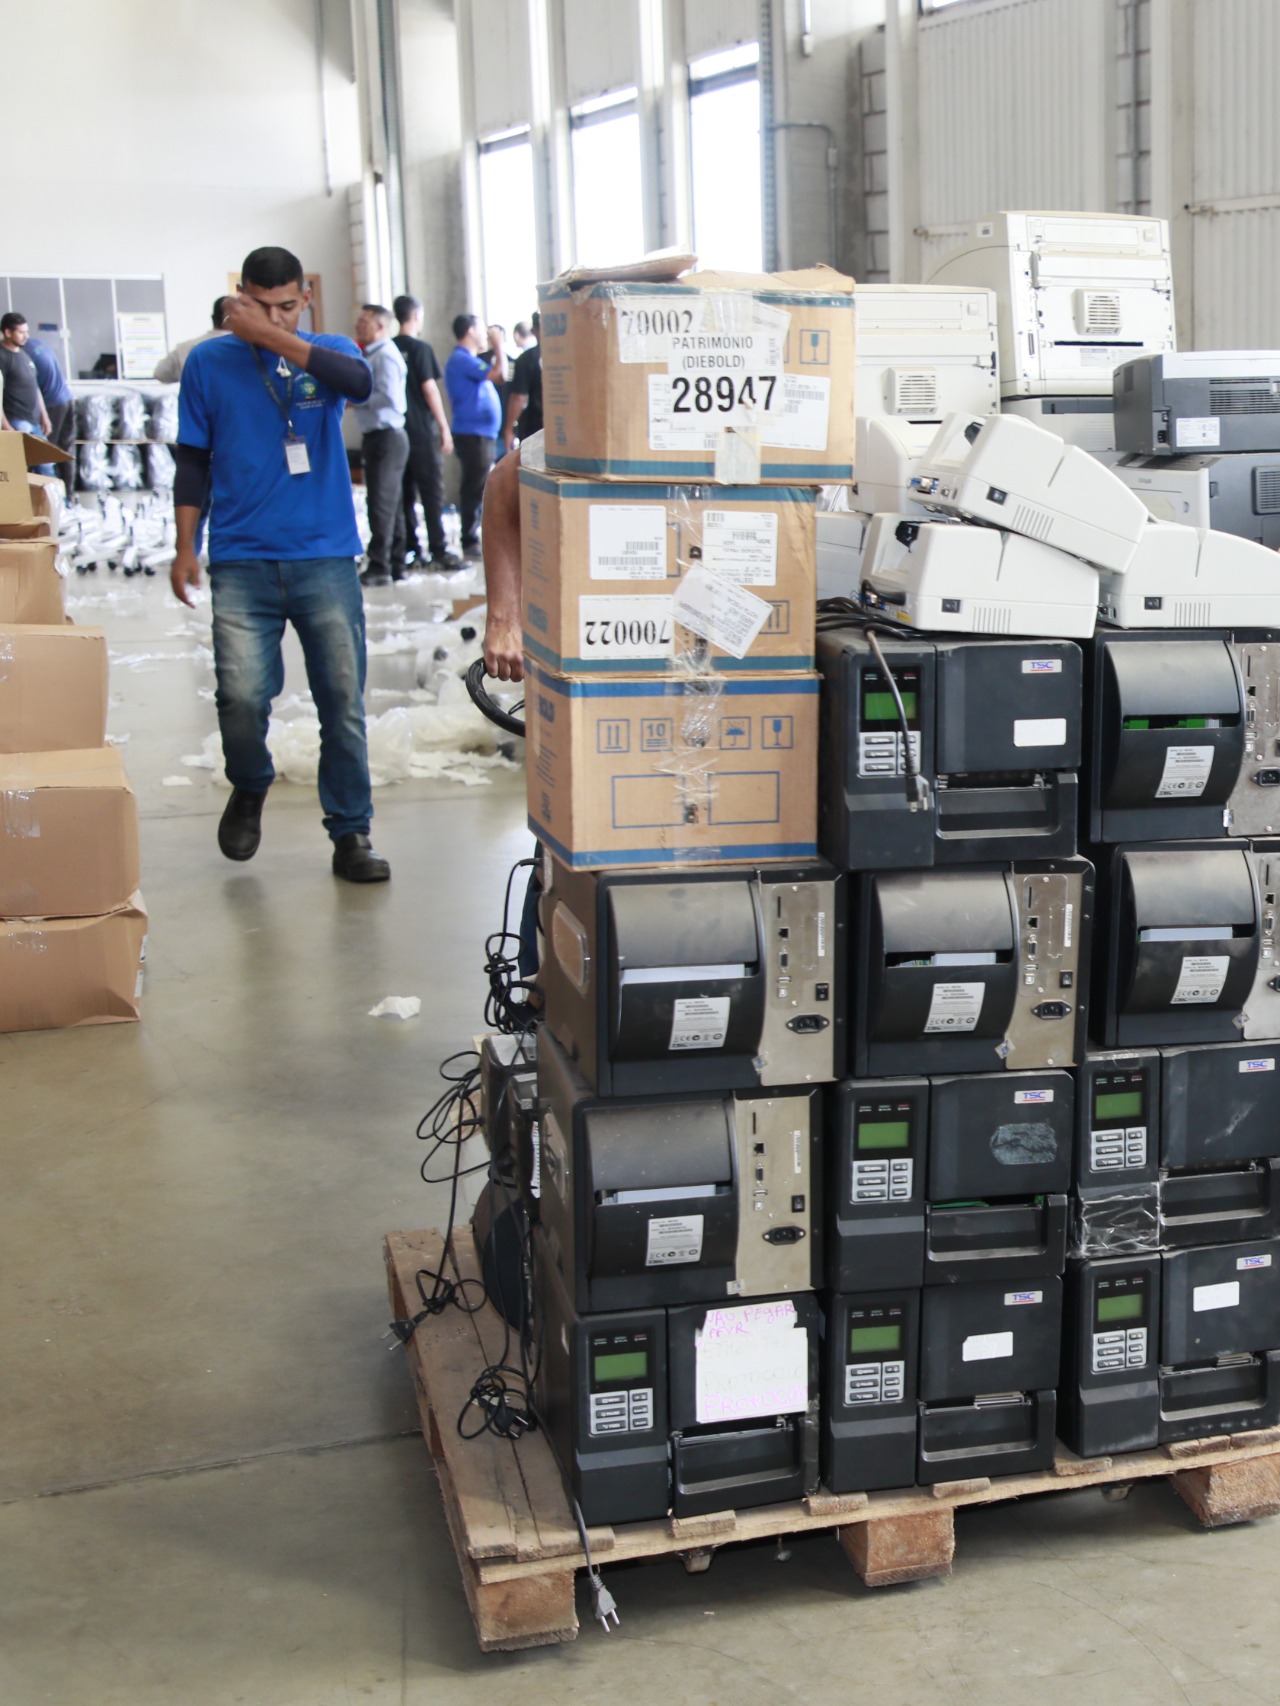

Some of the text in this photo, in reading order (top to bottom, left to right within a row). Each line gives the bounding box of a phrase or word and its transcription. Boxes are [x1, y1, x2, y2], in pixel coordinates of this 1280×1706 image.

[682, 355, 745, 371] (DIEBOLD)
[672, 376, 777, 413] 28947
[585, 620, 671, 645] 700022
[1030, 660, 1053, 668] TSC
[647, 723, 665, 737] 10
[1247, 1060, 1268, 1068] TSC
[1023, 1091, 1046, 1099] TSC
[1243, 1256, 1264, 1264] TSC
[1012, 1292, 1035, 1300] TSC
